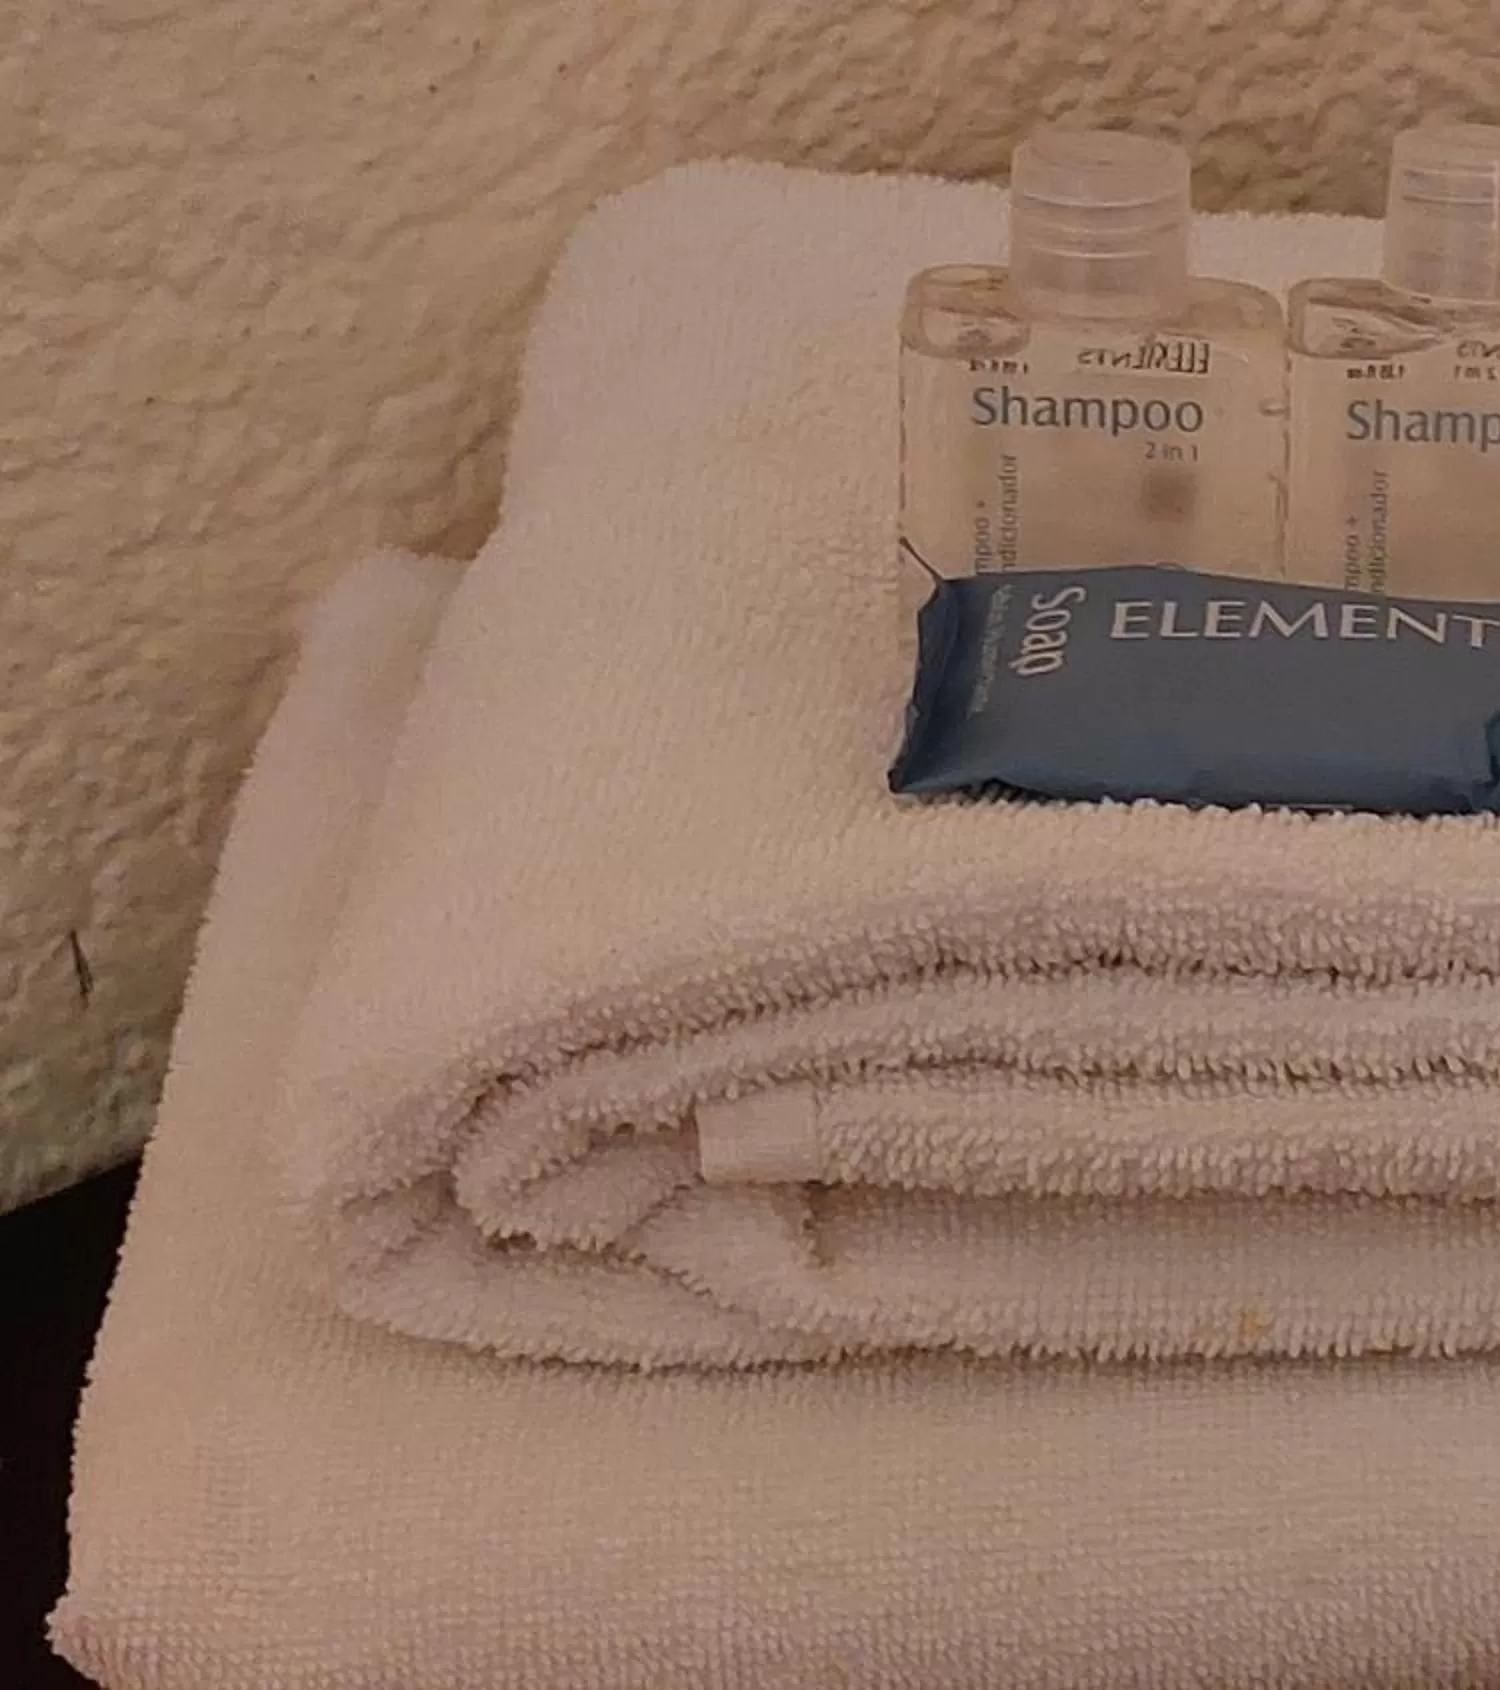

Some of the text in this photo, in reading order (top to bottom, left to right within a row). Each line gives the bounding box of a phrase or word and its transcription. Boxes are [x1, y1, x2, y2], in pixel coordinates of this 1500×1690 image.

[972, 386, 1204, 436] Shampoo
[1144, 443, 1199, 462] 2 in 1
[1008, 586, 1087, 675] Soap
